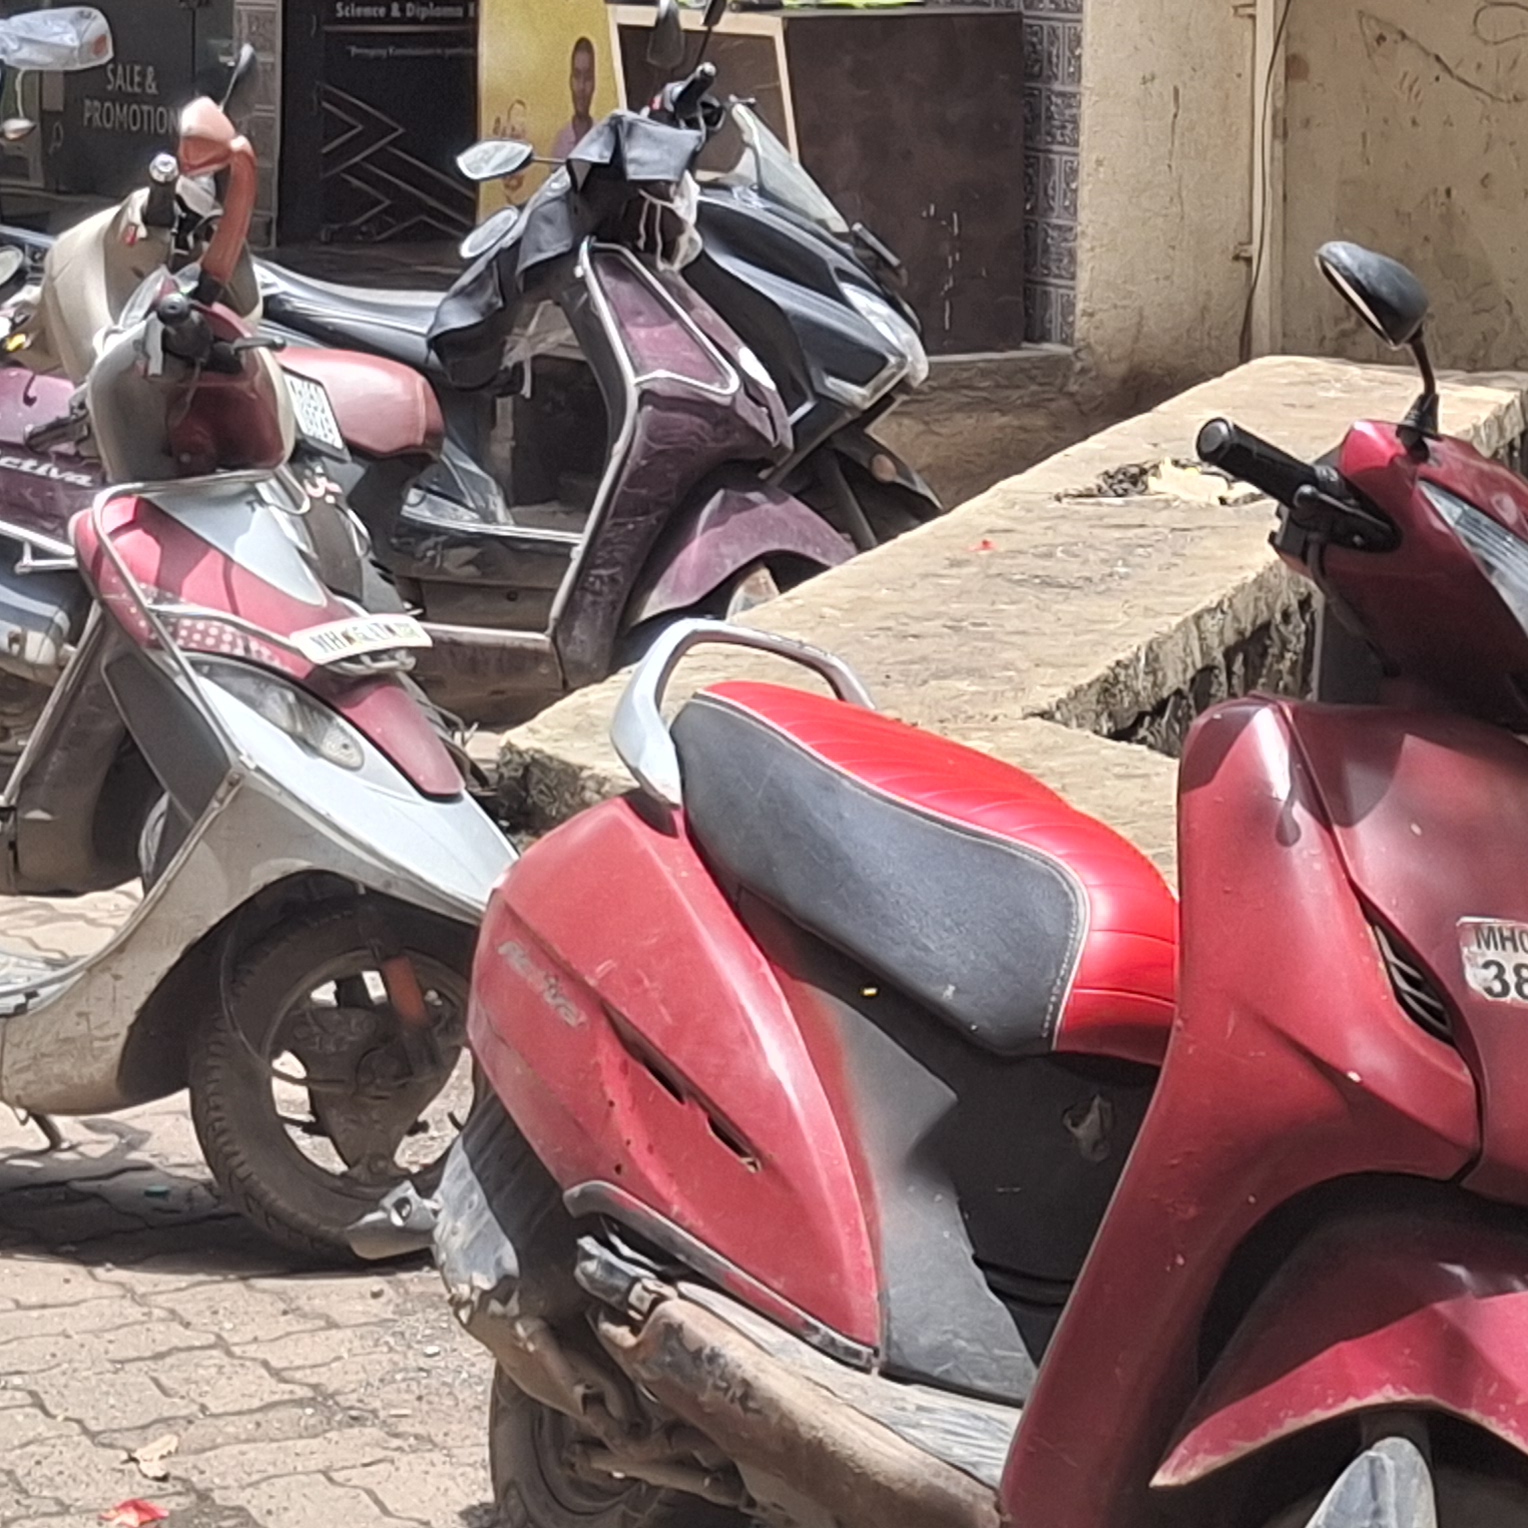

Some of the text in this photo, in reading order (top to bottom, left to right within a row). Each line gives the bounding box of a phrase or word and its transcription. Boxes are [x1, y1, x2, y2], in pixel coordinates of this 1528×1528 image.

[336, 1, 386, 18] Science
[406, 1, 464, 21] Diploma
[106, 63, 158, 95] SALE &
[0, 456, 94, 488] ctiva
